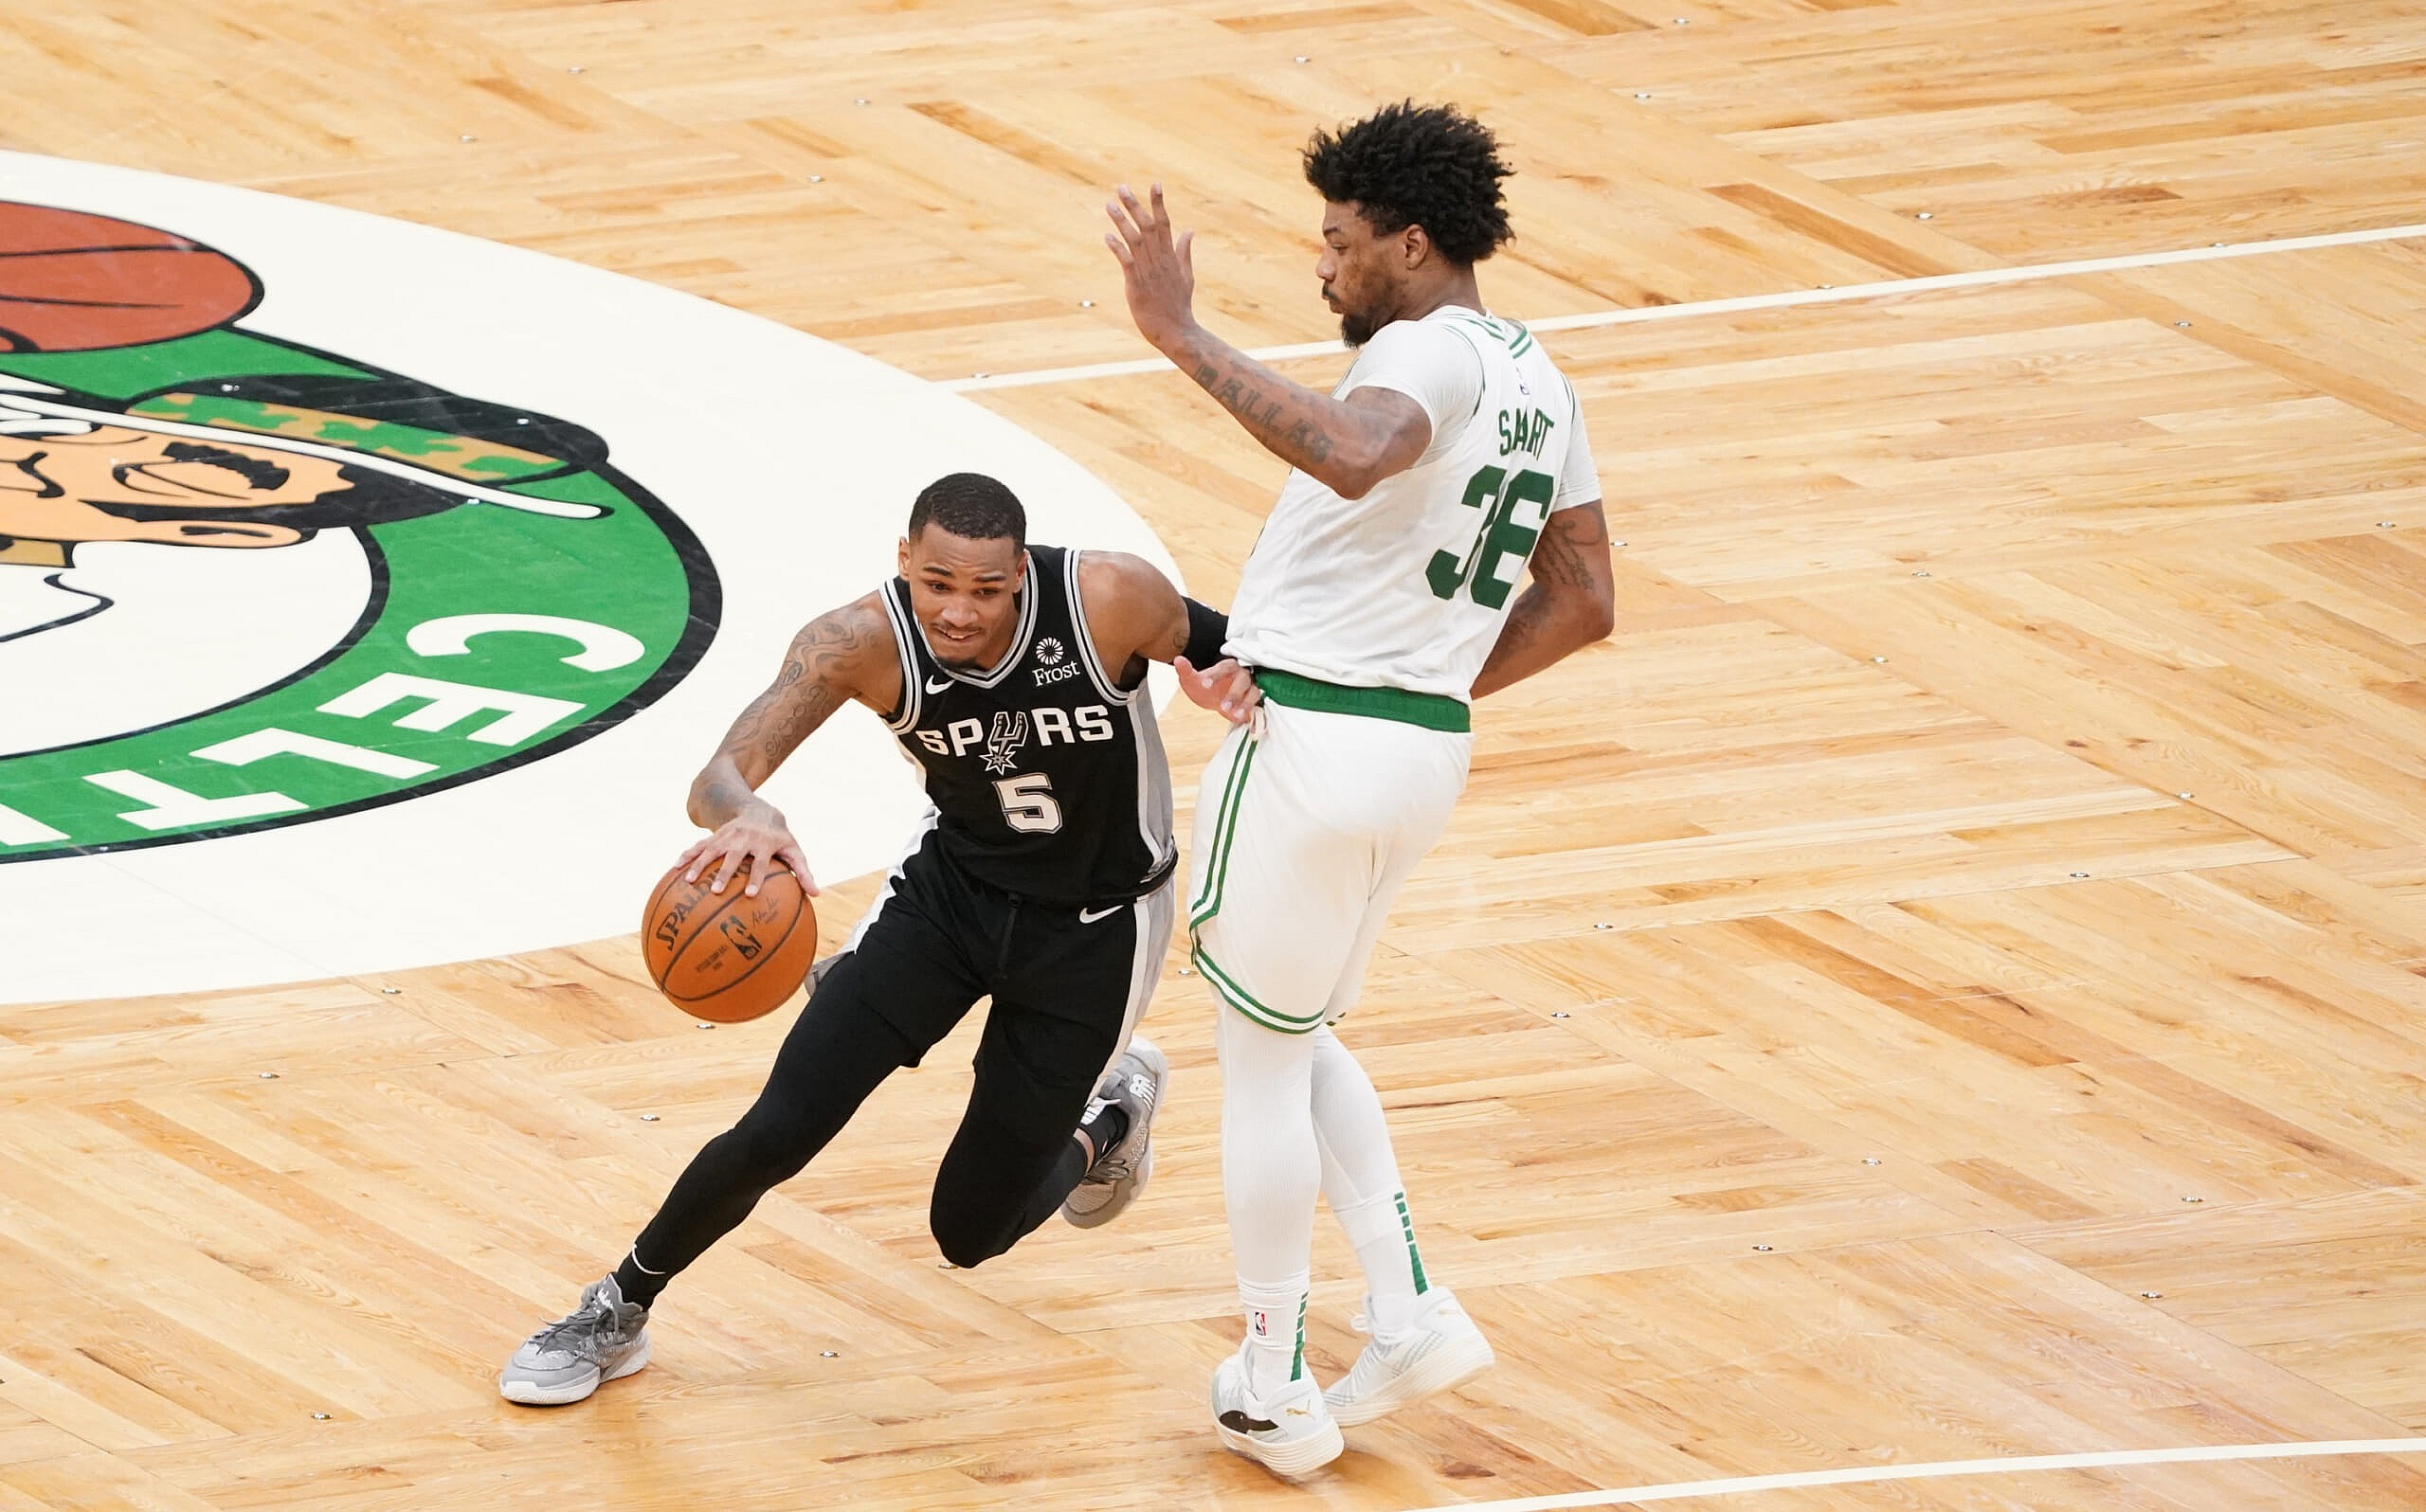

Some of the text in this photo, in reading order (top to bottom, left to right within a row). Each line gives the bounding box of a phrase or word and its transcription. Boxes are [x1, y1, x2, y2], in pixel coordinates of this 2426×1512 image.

[1498, 407, 1555, 461] SMART
[1425, 464, 1554, 610] 36
[1032, 659, 1080, 687] Frost
[915, 704, 1114, 775] SPURS
[992, 772, 1063, 834] 5
